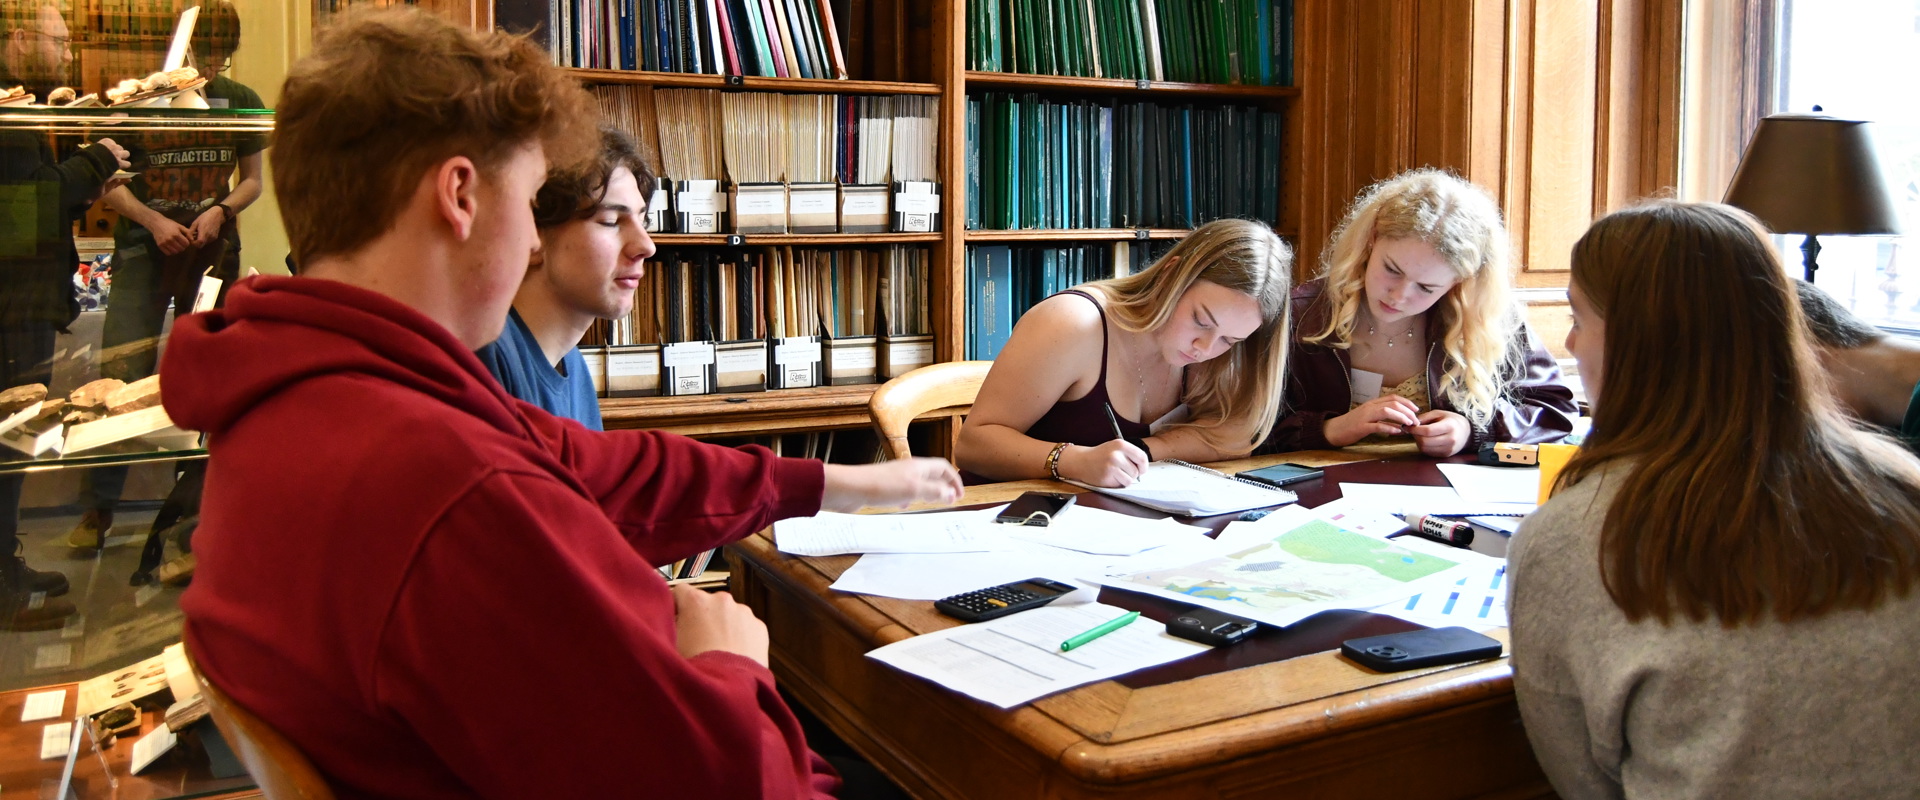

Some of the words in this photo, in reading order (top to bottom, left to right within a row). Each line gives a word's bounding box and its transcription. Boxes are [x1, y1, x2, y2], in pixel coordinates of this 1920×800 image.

[731, 76, 739, 85] C
[149, 150, 217, 164] DISTRACTED
[220, 150, 232, 162] BY
[1140, 231, 1147, 239] D
[733, 236, 741, 245] D
